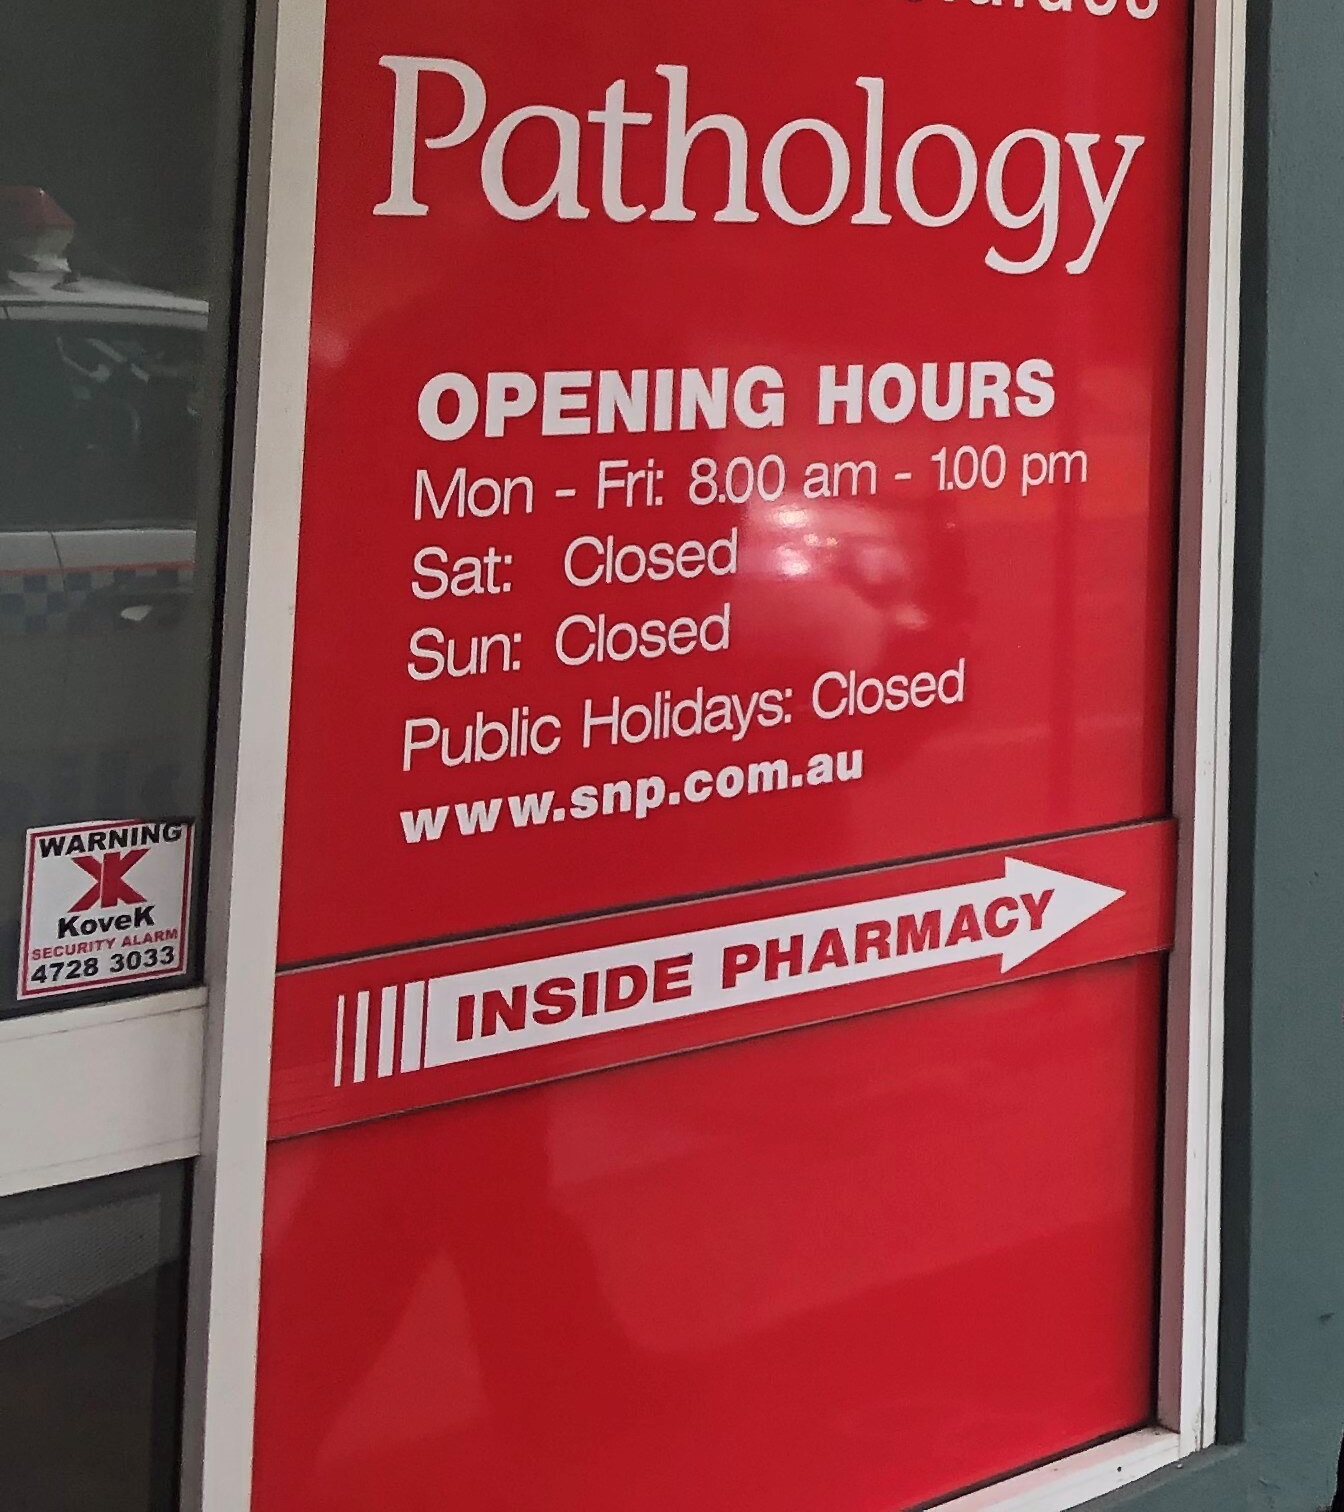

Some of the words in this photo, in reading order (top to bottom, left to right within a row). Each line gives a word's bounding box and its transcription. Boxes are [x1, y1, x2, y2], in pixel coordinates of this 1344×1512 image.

[372, 55, 1145, 275] Pathology
[416, 364, 785, 442] OPENING
[817, 358, 1056, 426] HOURS
[413, 467, 534, 520] Mon
[597, 458, 665, 510] Fri:
[689, 453, 787, 505] 8.00
[803, 457, 878, 500] am
[931, 444, 1006, 491] 1.00
[1021, 445, 1089, 495] pm
[410, 547, 513, 600] Sat:
[564, 527, 738, 590] Closed
[407, 626, 521, 682] Sun:
[554, 605, 731, 667] Closed
[401, 707, 561, 772] Public
[582, 686, 794, 749] Holidays:
[811, 660, 965, 720] Closed
[401, 745, 864, 843] www.snp.com.au
[39, 823, 183, 859] WARNING
[31, 937, 117, 962] SECURITY
[121, 927, 179, 948] ALARM
[31, 957, 99, 984] 4728
[109, 945, 175, 973] 3033
[454, 954, 693, 1042] INSIDE
[722, 889, 1056, 990] PHARMACY
